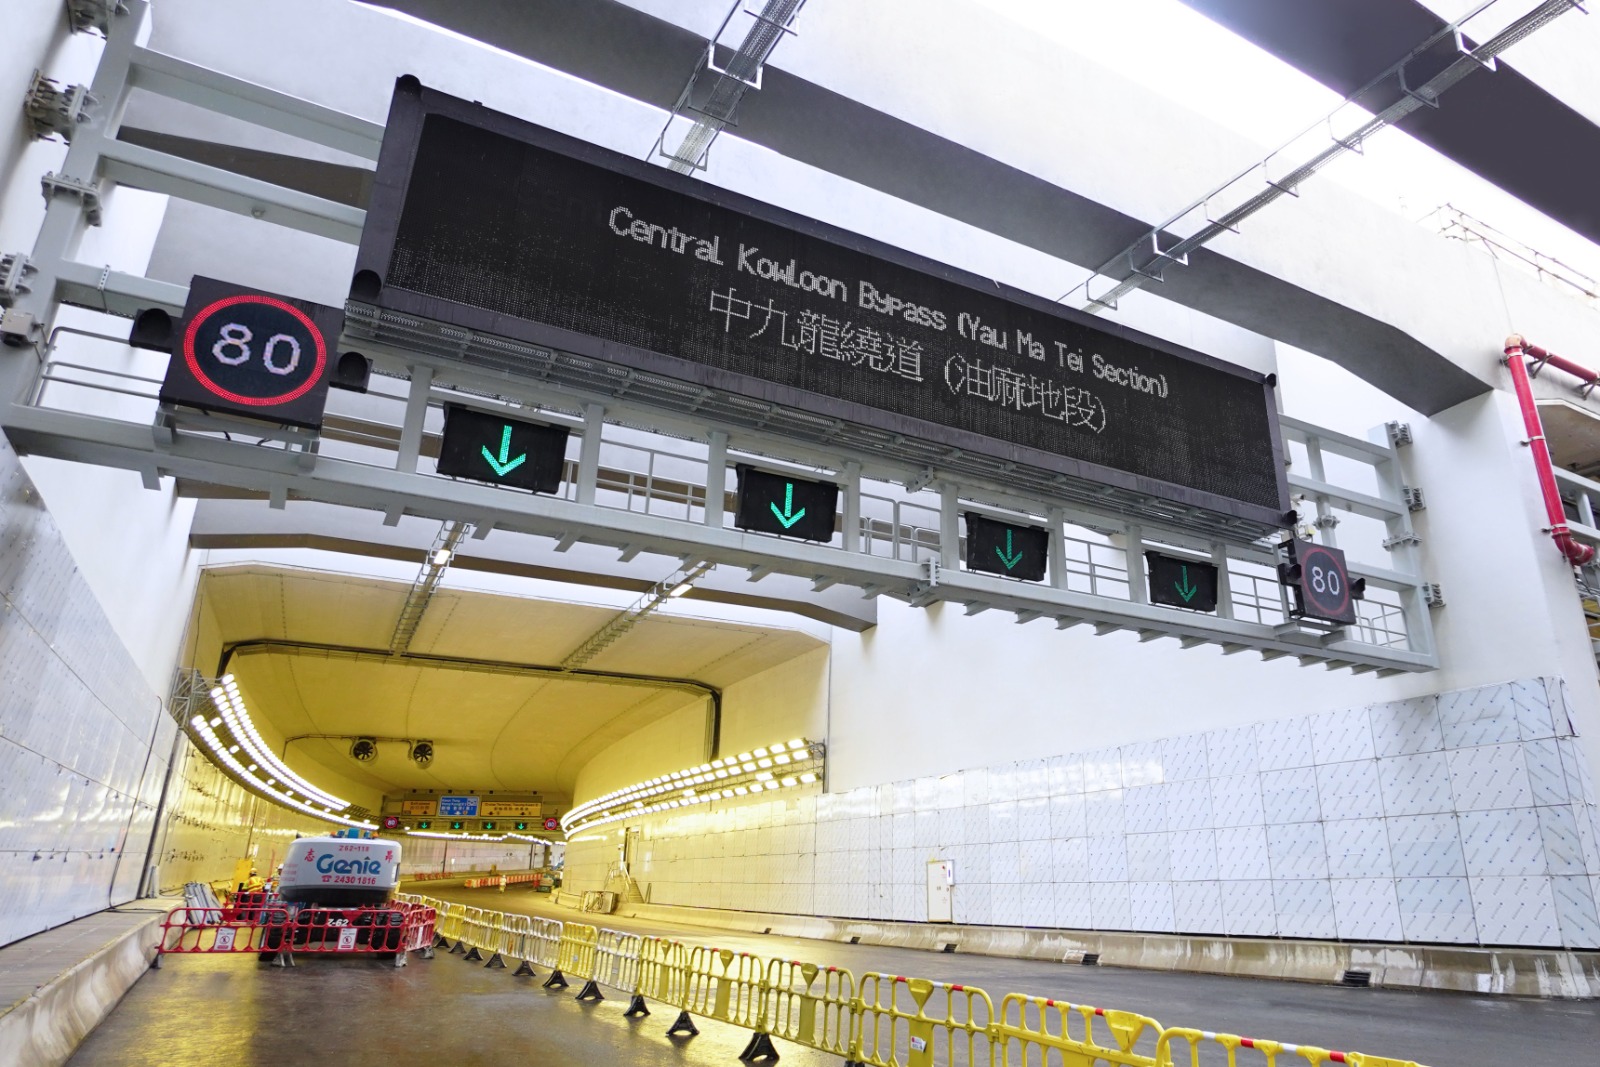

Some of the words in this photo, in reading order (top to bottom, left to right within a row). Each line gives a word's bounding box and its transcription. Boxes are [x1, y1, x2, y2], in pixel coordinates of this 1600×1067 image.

[608, 205, 724, 266] Central
[737, 243, 848, 303] Kowloon
[859, 280, 947, 331] Bypass
[957, 311, 1008, 351] (Yau
[1016, 328, 1046, 362] Ma
[1054, 340, 1085, 374] Tei
[1091, 352, 1170, 399] Section)
[212, 322, 301, 376] 80
[709, 287, 925, 382] 中九龍繞道
[944, 352, 1107, 434] （油麻地段）
[1311, 565, 1340, 596] 80
[316, 853, 382, 875] Genie
[334, 875, 356, 884] 2430
[357, 876, 377, 885] 1816
